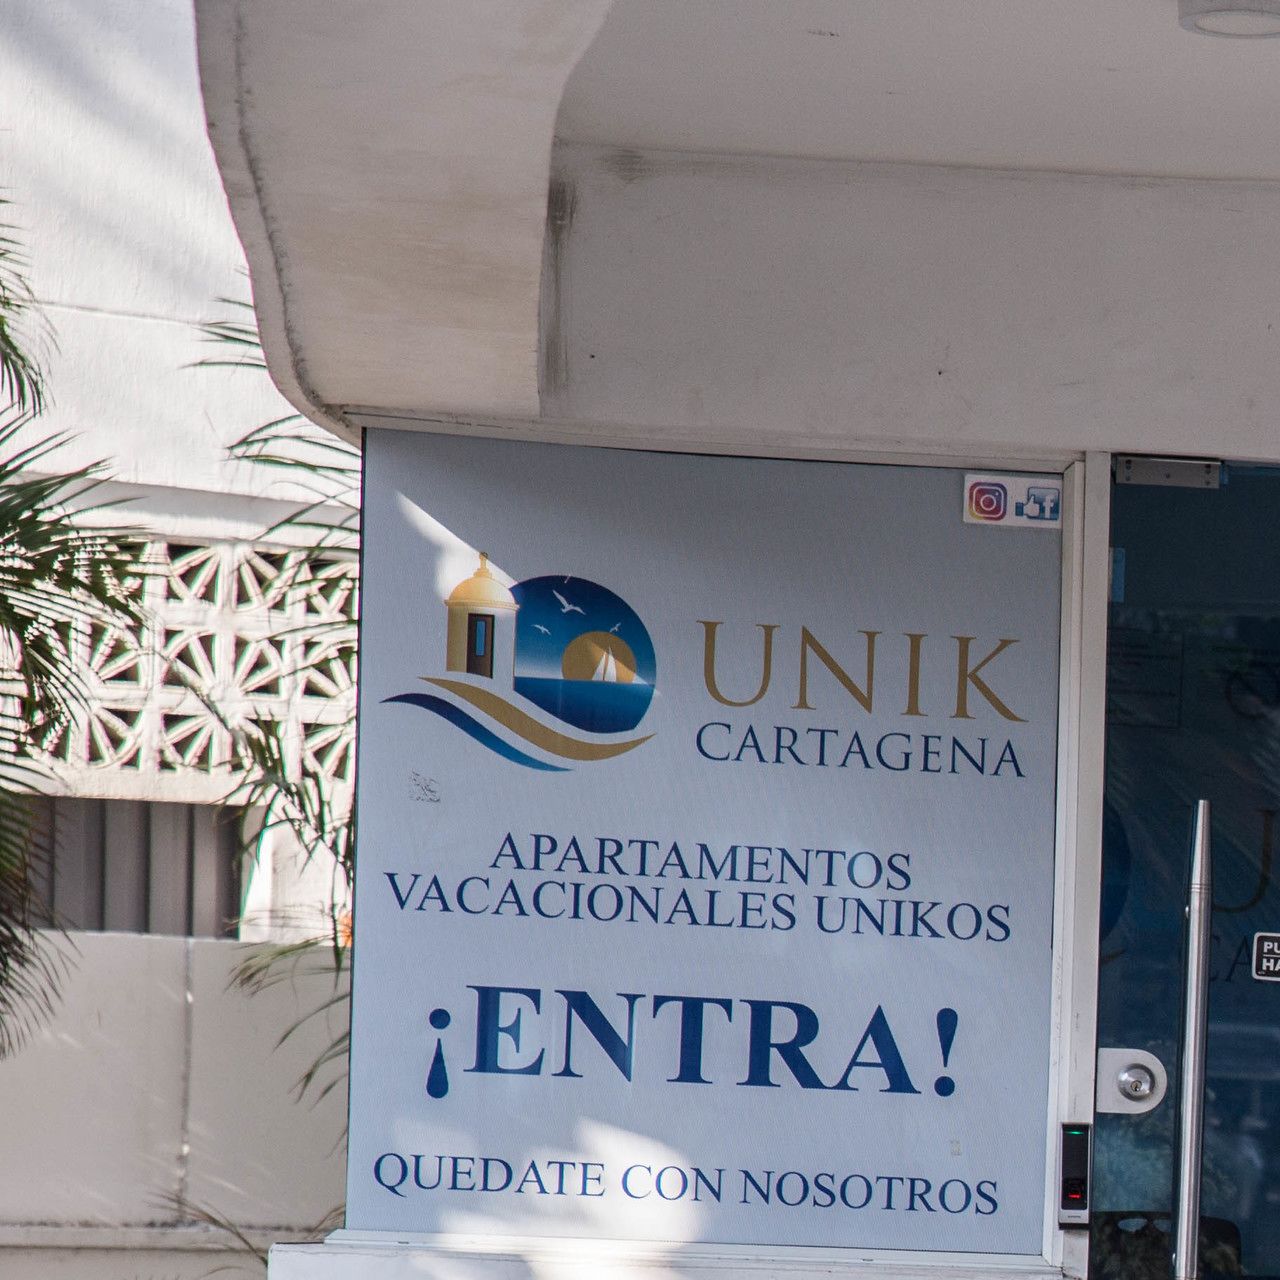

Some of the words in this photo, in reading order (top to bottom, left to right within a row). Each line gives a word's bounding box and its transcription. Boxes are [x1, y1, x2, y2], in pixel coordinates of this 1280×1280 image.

[696, 620, 1029, 723] UNIK
[696, 721, 1026, 779] CARTAGENA
[489, 832, 912, 892] APARTAMENTOS
[383, 871, 797, 932] VACACIONALES
[814, 896, 1012, 943] UNIKOS
[426, 985, 960, 1100] ¡ENTRA!
[373, 1152, 605, 1198] QUEDATE
[621, 1164, 726, 1203] CON
[739, 1169, 999, 1216] NOSOTROS
